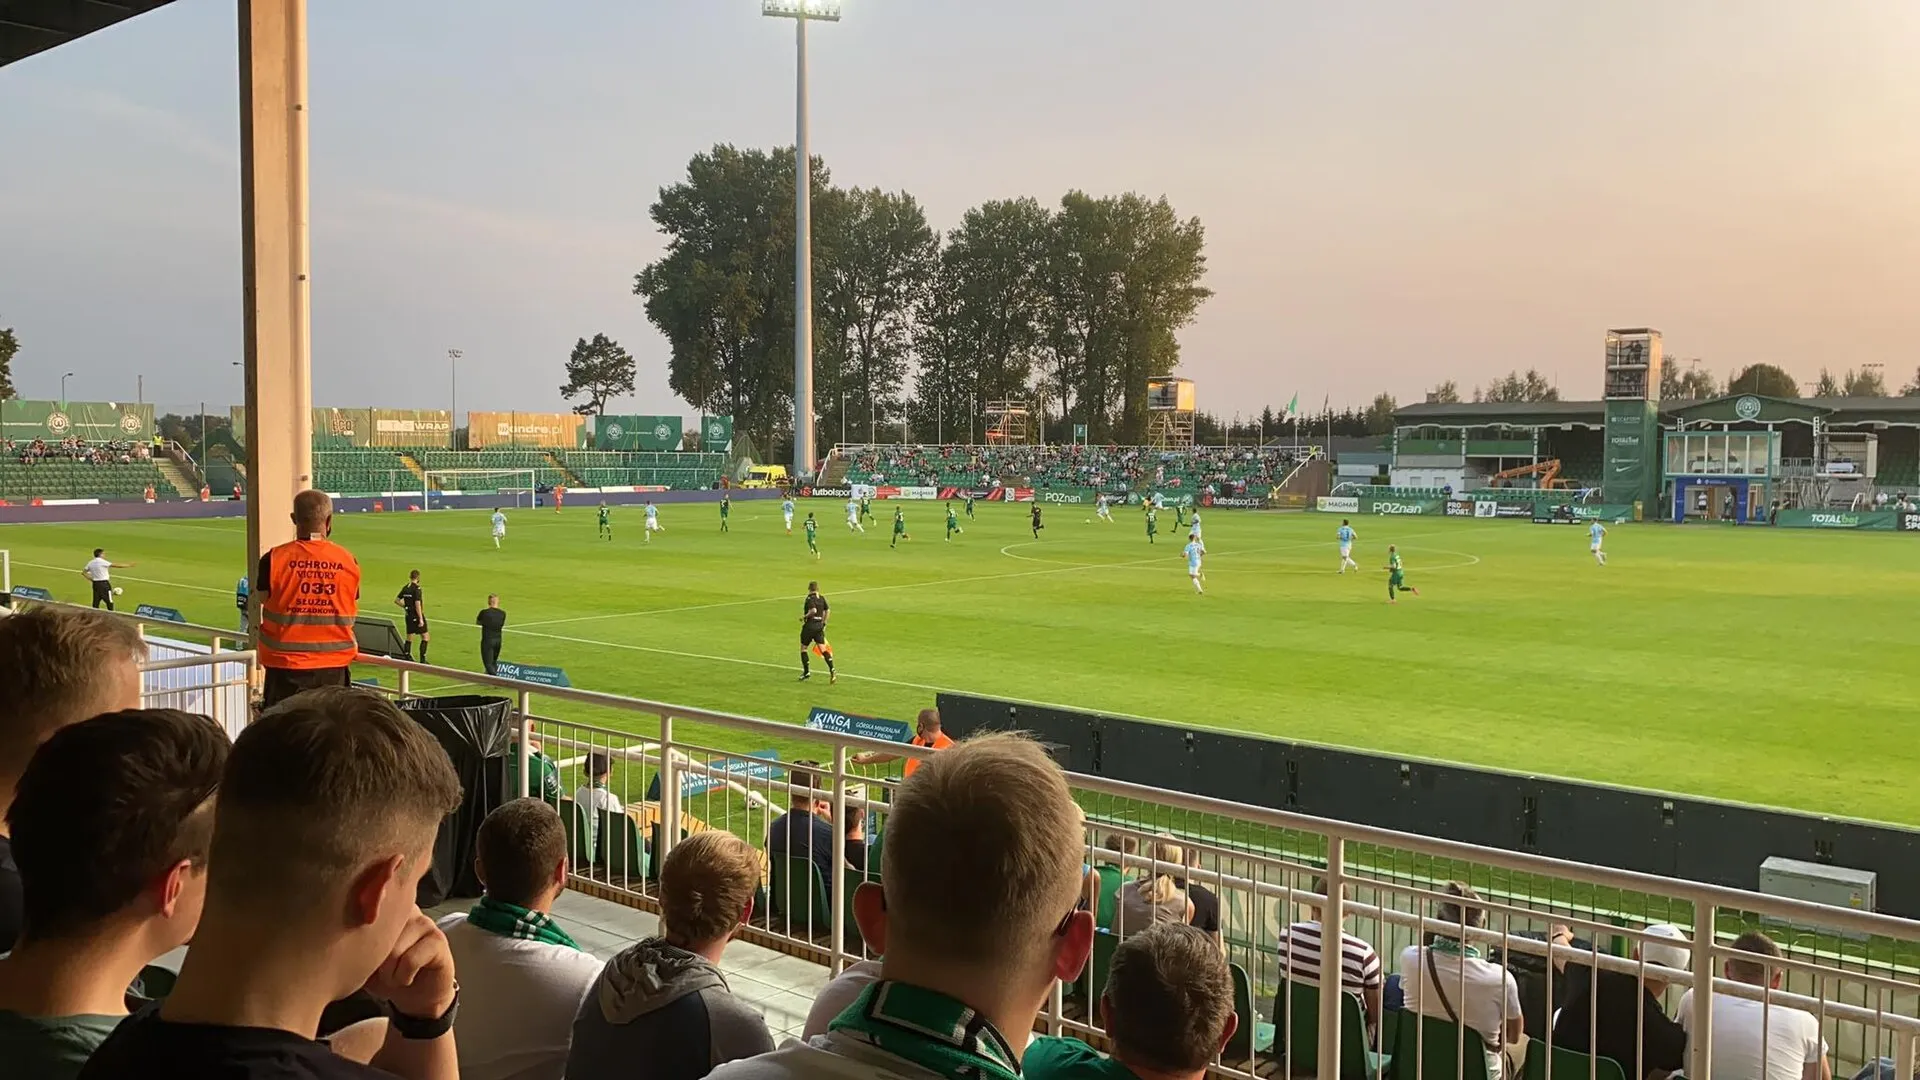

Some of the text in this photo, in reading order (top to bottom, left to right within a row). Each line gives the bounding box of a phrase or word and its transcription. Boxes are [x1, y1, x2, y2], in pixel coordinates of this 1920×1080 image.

[812, 486, 851, 497] futbolspor
[1045, 492, 1081, 503] POZnan
[1373, 502, 1422, 514] POZnan
[1811, 513, 1858, 524] TOTALbet
[289, 561, 344, 570] OCHRONA
[296, 571, 336, 579] VICTORY
[301, 582, 336, 595] 033
[496, 663, 520, 676] INGA
[814, 712, 851, 729] KINGA
